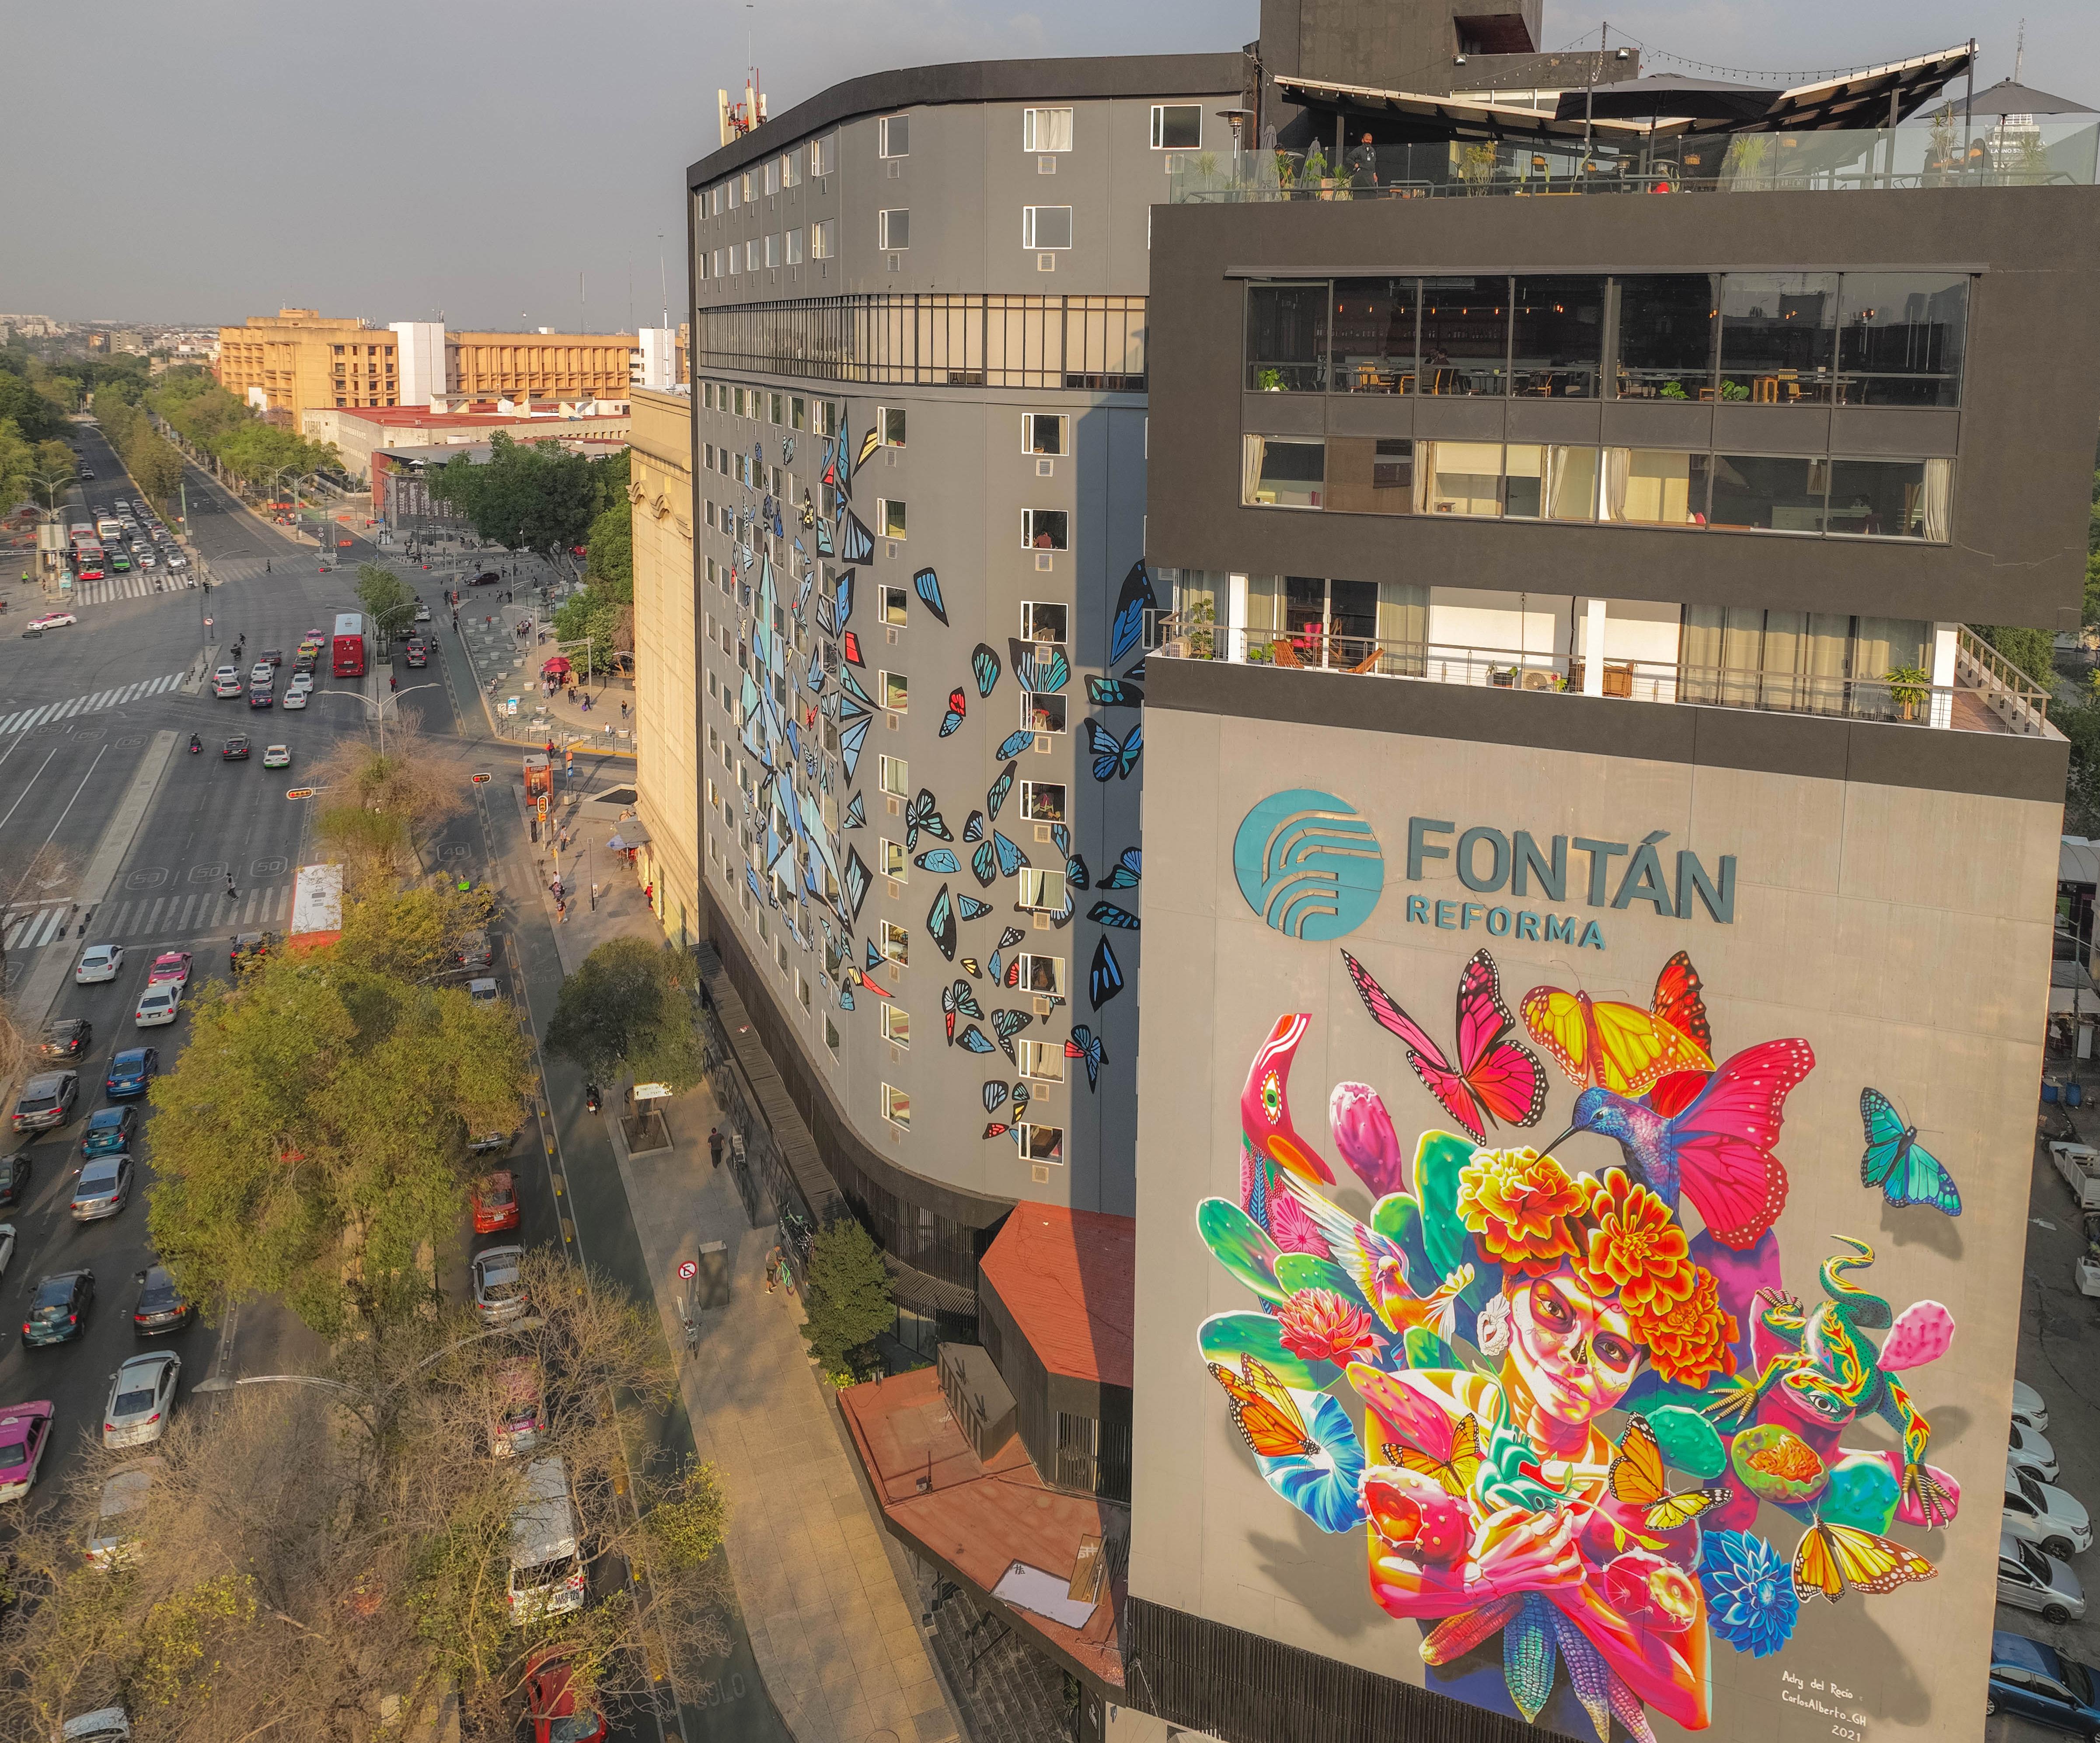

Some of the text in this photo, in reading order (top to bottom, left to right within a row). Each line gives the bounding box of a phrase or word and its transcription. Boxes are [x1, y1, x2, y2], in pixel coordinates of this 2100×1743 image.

[1406, 817, 1737, 924] FONTÁN
[1406, 895, 1606, 950] REFORMA
[1782, 1670, 1803, 1690] Adry
[1810, 1678, 1824, 1691] del
[1831, 1725, 1861, 1743] 2021
